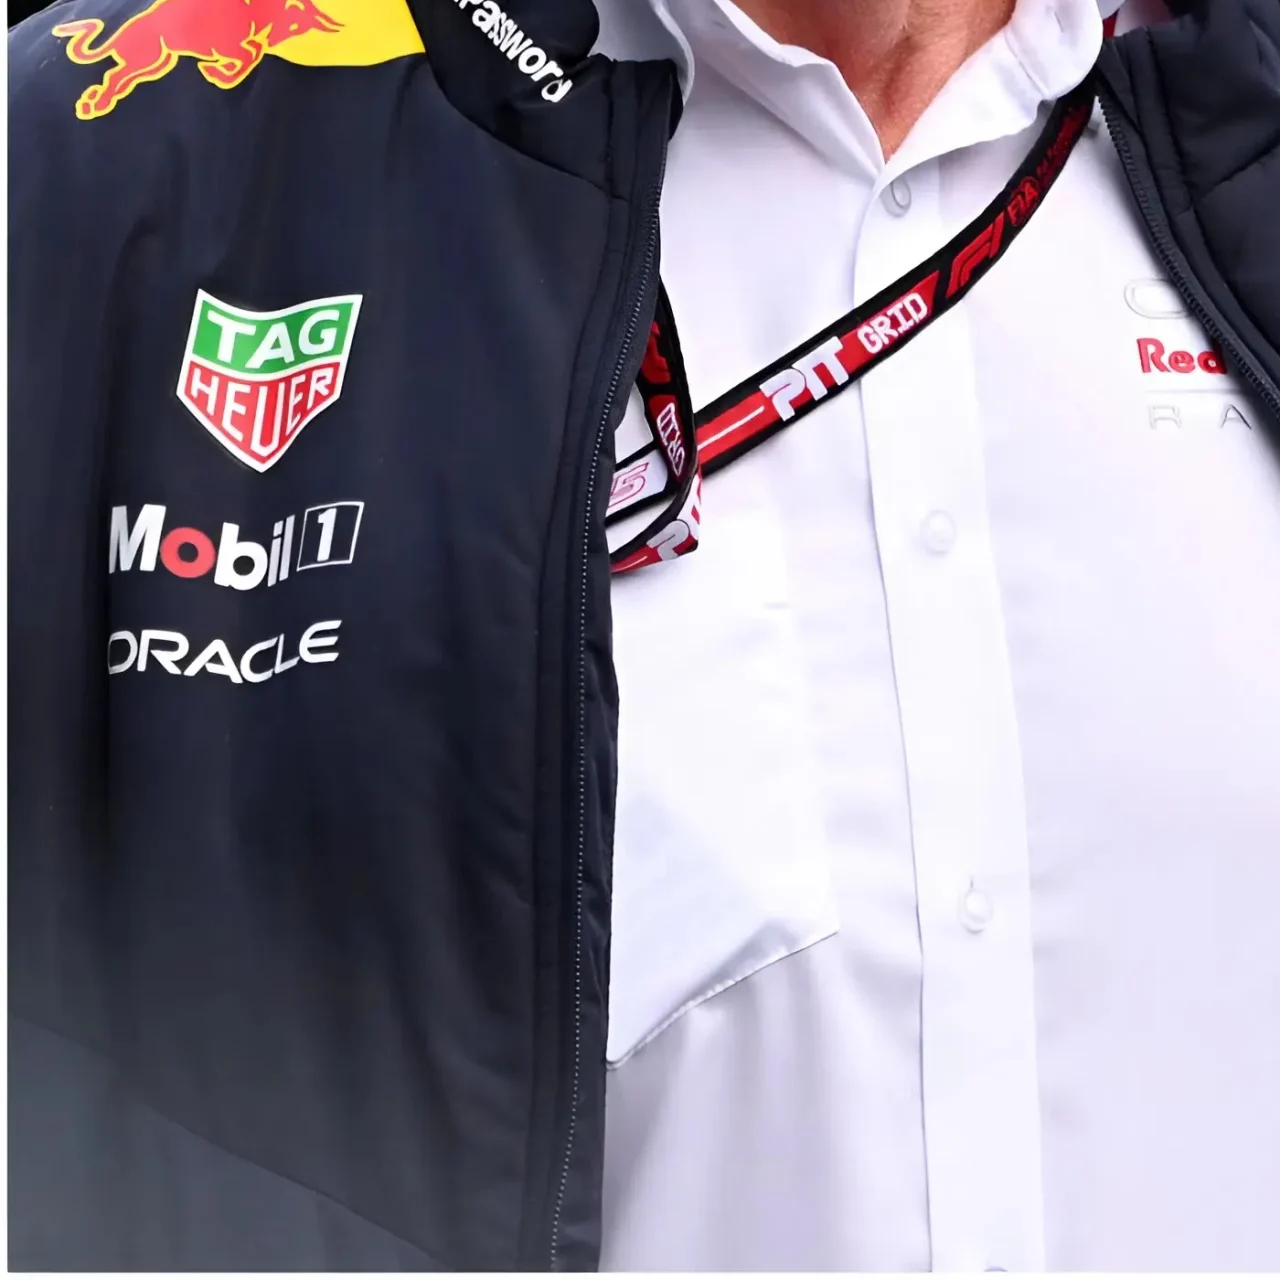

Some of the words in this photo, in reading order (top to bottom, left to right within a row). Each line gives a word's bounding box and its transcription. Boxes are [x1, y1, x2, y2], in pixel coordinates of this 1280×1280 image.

[206, 308, 340, 369] TAG
[857, 291, 929, 354] GRID
[190, 366, 333, 458] HEUER
[108, 503, 296, 591] Mobil
[107, 620, 343, 684] ORACLE
